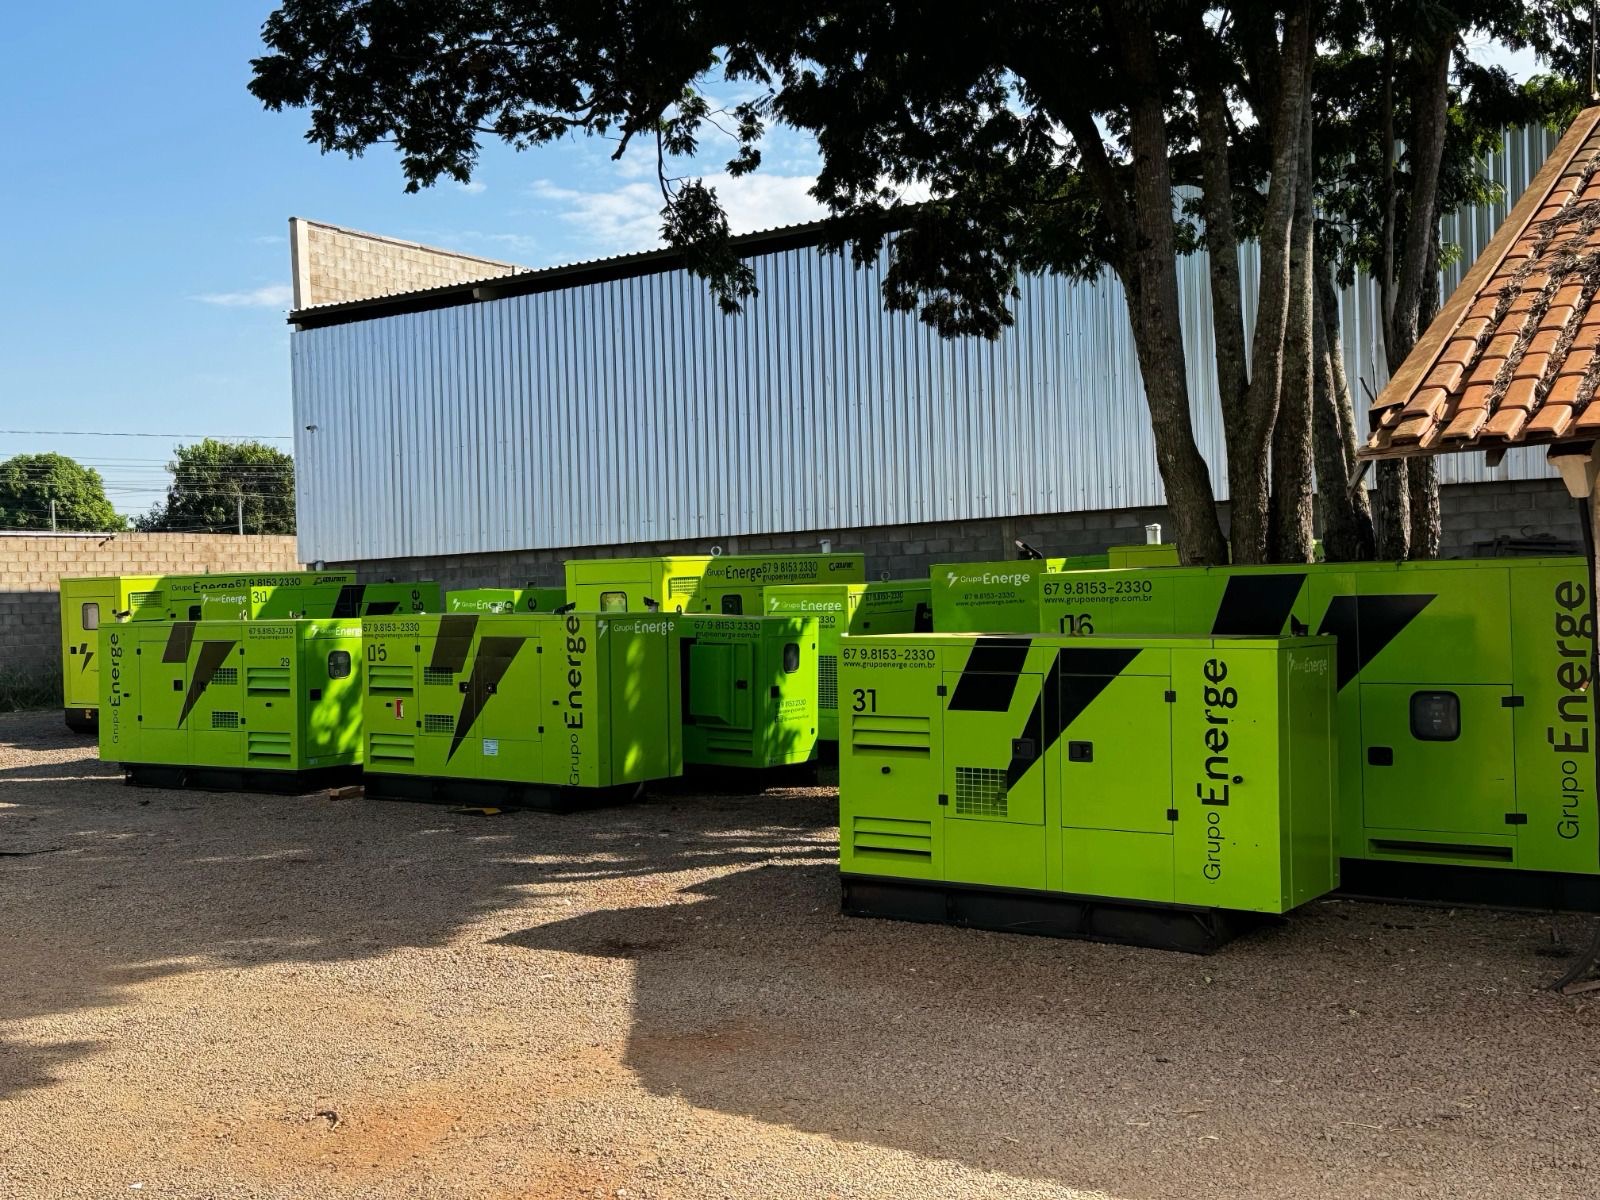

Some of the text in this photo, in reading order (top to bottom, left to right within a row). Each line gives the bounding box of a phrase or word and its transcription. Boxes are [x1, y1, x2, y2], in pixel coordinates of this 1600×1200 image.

[725, 565, 763, 582] Energe
[762, 562, 772, 573] 67
[773, 562, 779, 572] 9
[780, 561, 798, 573] 8153
[799, 561, 818, 572] 2330
[235, 577, 301, 588] 67 9 8153 2330
[960, 572, 1031, 586] Grupo Energe
[1043, 580, 1153, 596] 67 9.8153-2330
[800, 600, 842, 613] Energe
[613, 620, 675, 636] Grupo Energe
[694, 620, 705, 629] 67
[707, 621, 713, 629] 9
[737, 622, 761, 631] 2330
[843, 648, 936, 661] 67 9.8153-2330
[843, 661, 936, 670] www.grupoenerge.com.br
[109, 633, 123, 744] Grupo Energe
[563, 615, 587, 786] Grupo Energe
[852, 688, 877, 713] 31
[1547, 580, 1592, 840] Grupo Energe
[1196, 658, 1238, 881] Grupo Energe
